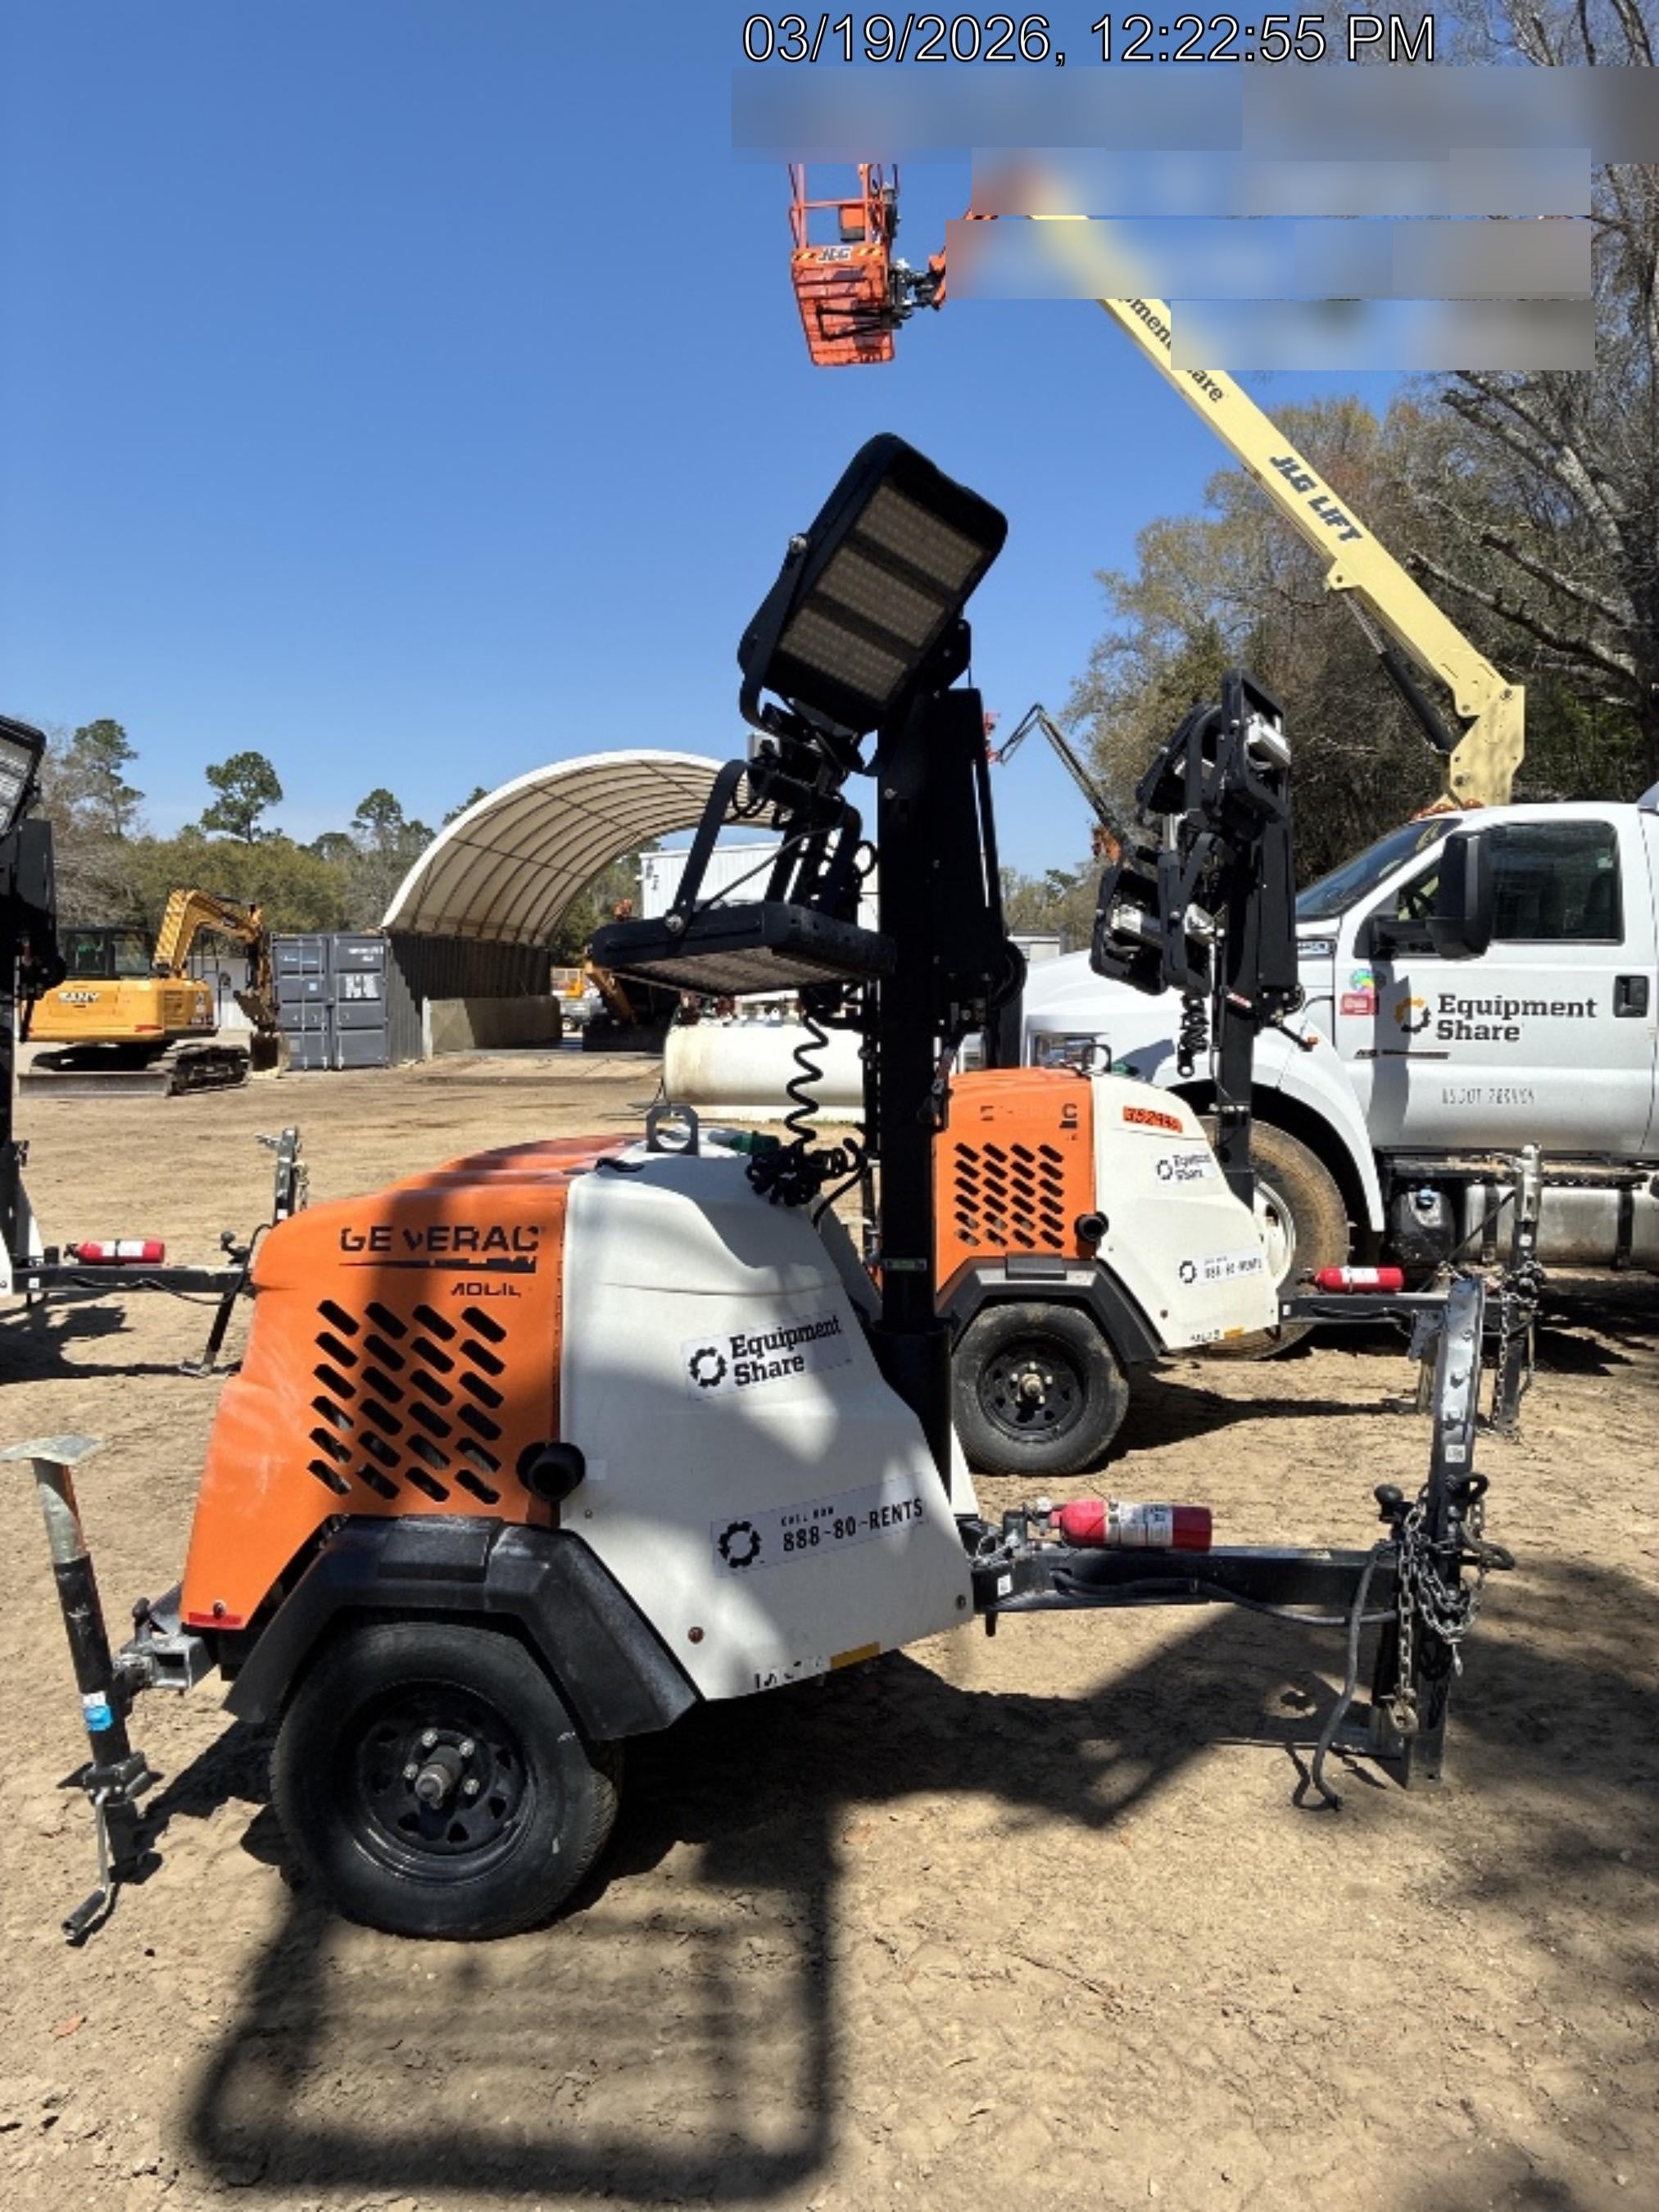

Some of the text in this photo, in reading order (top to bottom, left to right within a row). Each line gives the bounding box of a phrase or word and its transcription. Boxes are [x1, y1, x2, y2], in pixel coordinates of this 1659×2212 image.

[1269, 456, 1363, 543] JLG LIFT
[1437, 994, 1598, 1022] Equipment
[1436, 1019, 1521, 1041] Share
[730, 1316, 841, 1359] Equipment
[734, 1354, 805, 1386] Share
[783, 1498, 923, 1552] 888-80-RENTS
